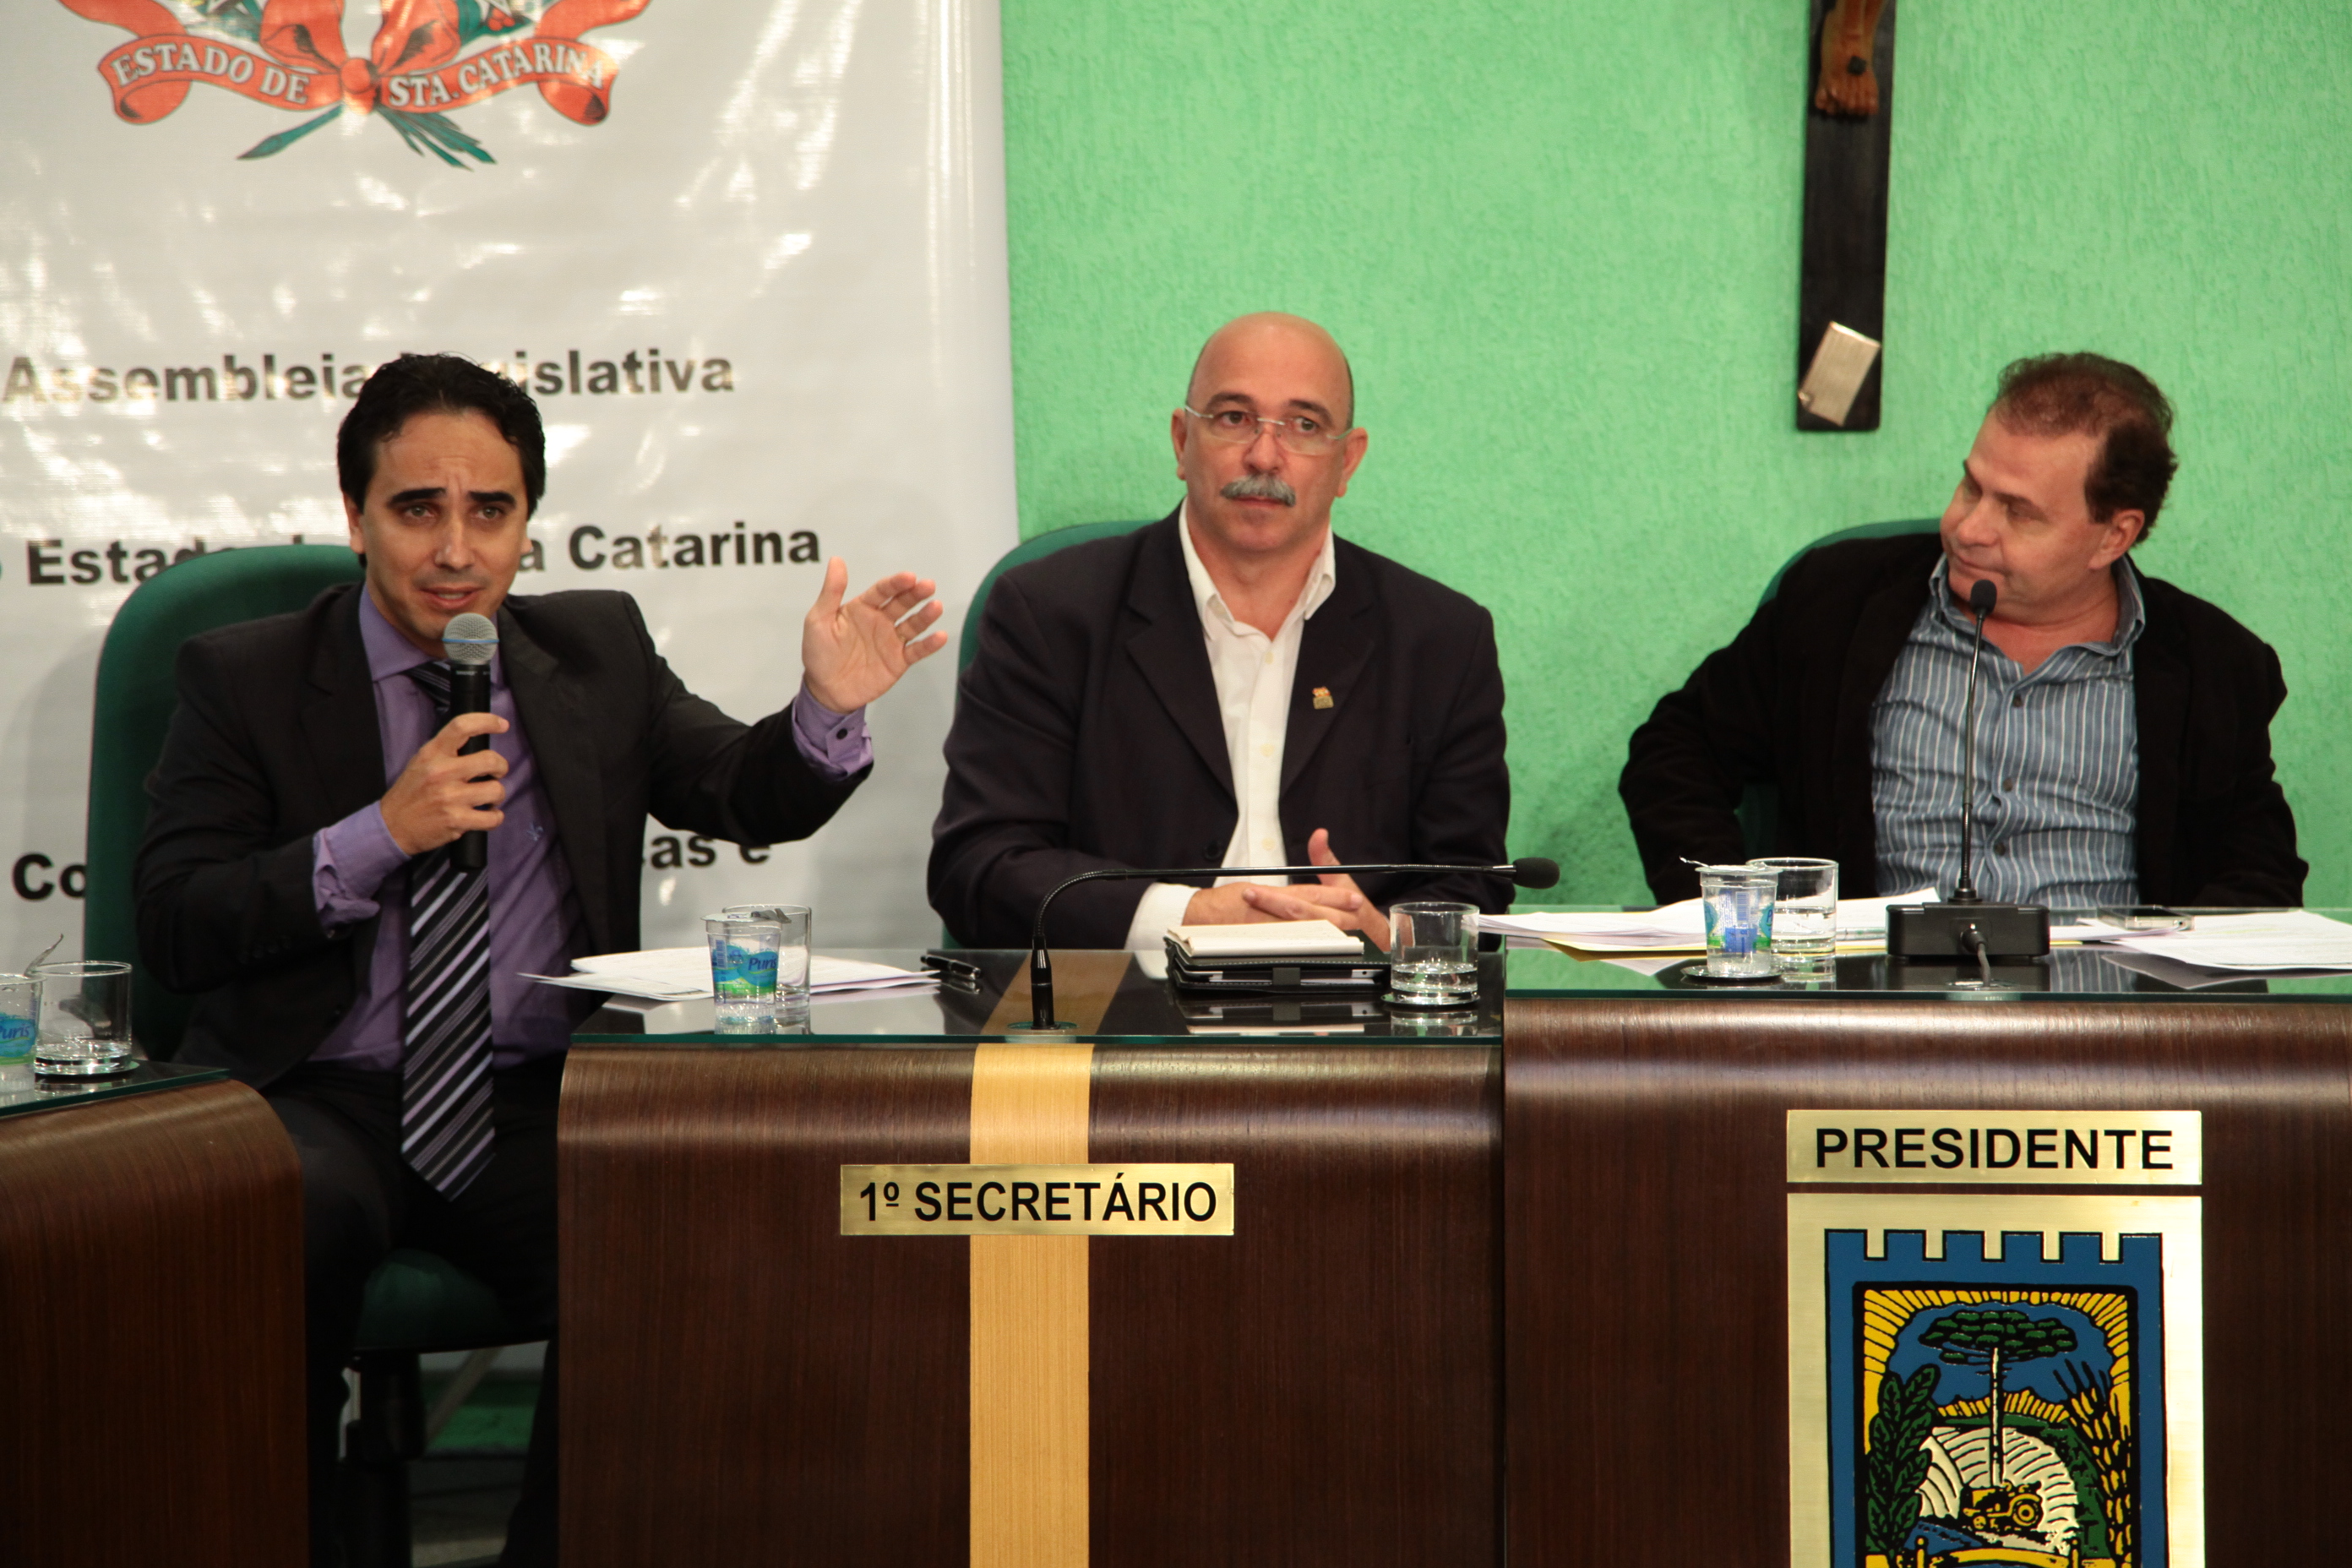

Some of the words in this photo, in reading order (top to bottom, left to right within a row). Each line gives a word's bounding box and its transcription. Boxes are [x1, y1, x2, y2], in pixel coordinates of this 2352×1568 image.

[111, 42, 254, 87] ESTADO
[259, 65, 310, 105] DE
[389, 73, 460, 107] STA.
[458, 43, 604, 90] CATARINA
[486, 348, 734, 395] islativa
[569, 521, 819, 570] Catarina
[1815, 1127, 2174, 1169] PRESIDENTE
[859, 1181, 901, 1222] 1º
[913, 1173, 1217, 1222] SECRETÁRIO
